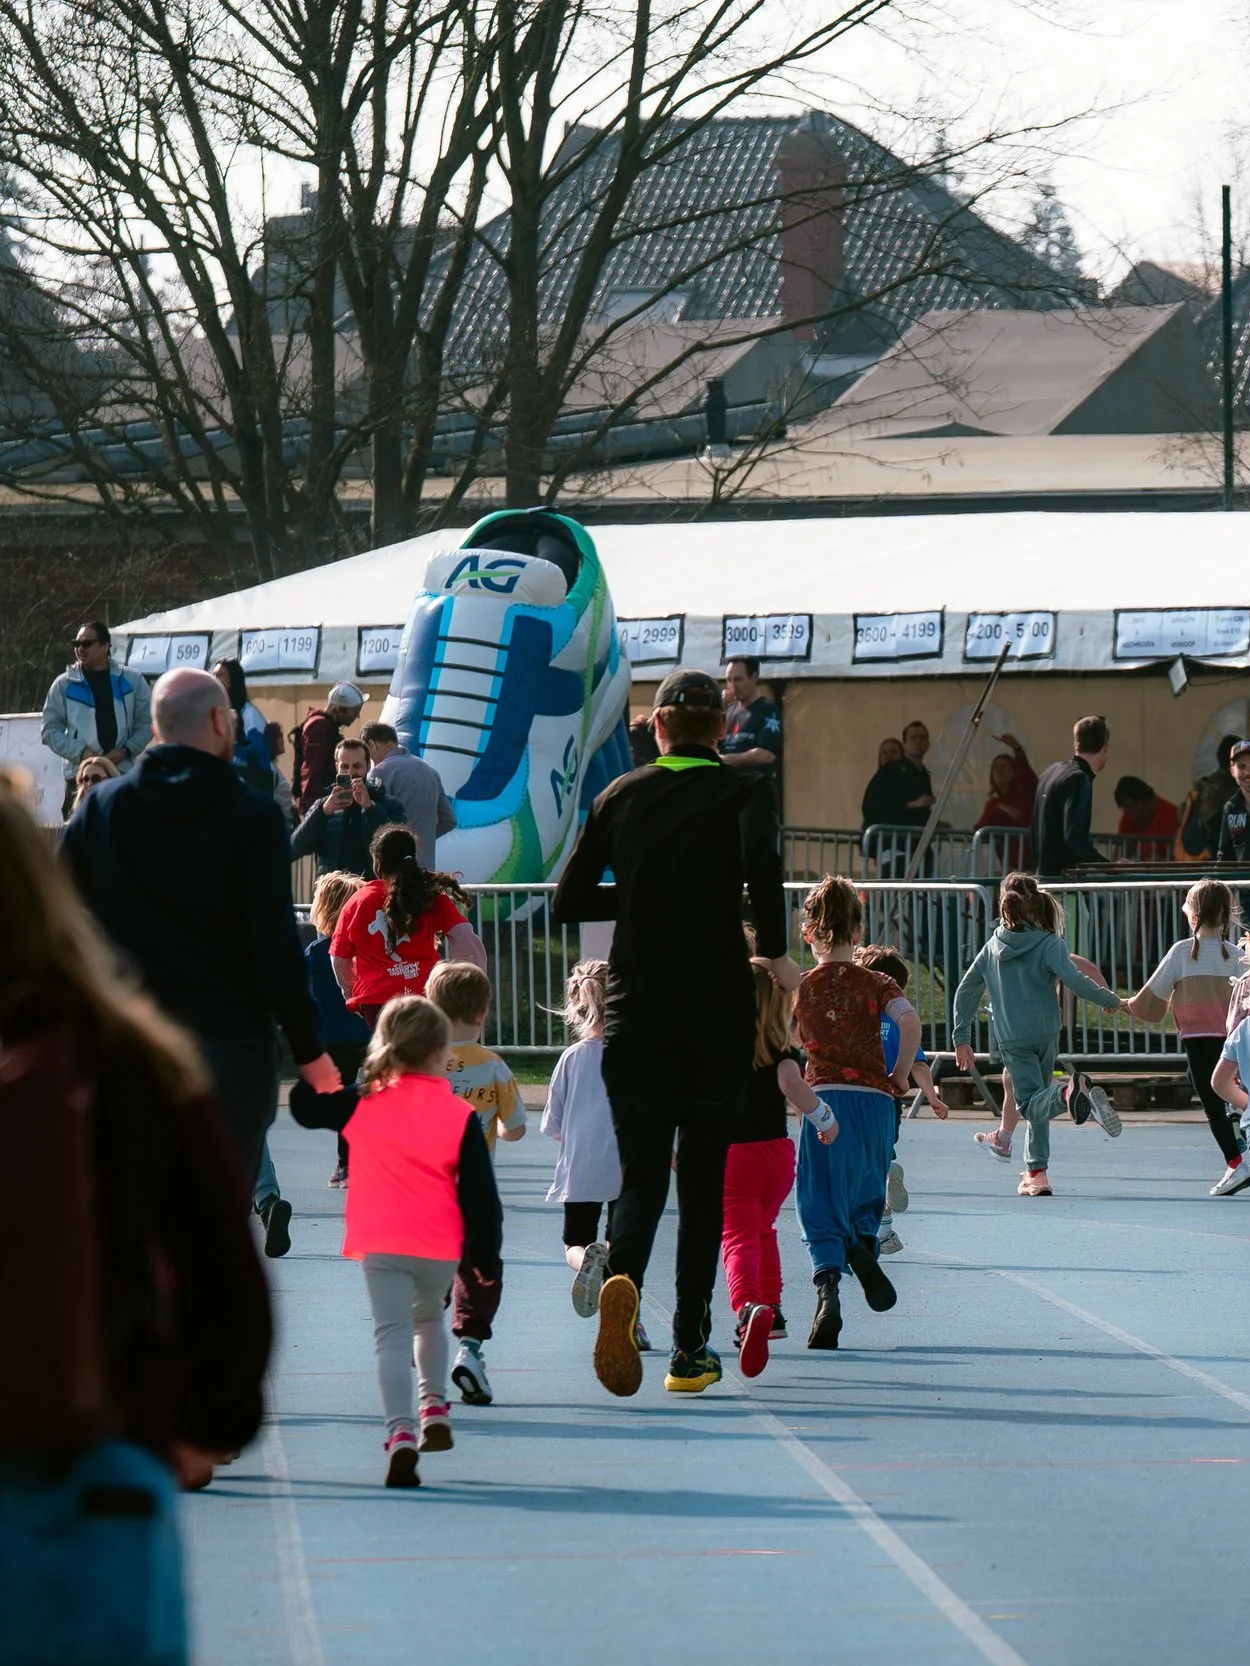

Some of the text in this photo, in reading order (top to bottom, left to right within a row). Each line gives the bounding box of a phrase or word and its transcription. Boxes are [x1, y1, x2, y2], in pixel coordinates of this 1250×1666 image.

[444, 554, 528, 595] AG
[643, 626, 677, 644] 2999
[727, 625, 757, 643] 3000
[857, 626, 887, 643] 3600
[902, 621, 936, 639] 4199
[967, 623, 1001, 640] 200
[1016, 621, 1049, 639] 500
[177, 644, 200, 661] 599
[245, 639, 266, 655] 600
[283, 636, 312, 654] 1199
[362, 638, 390, 655] 1200
